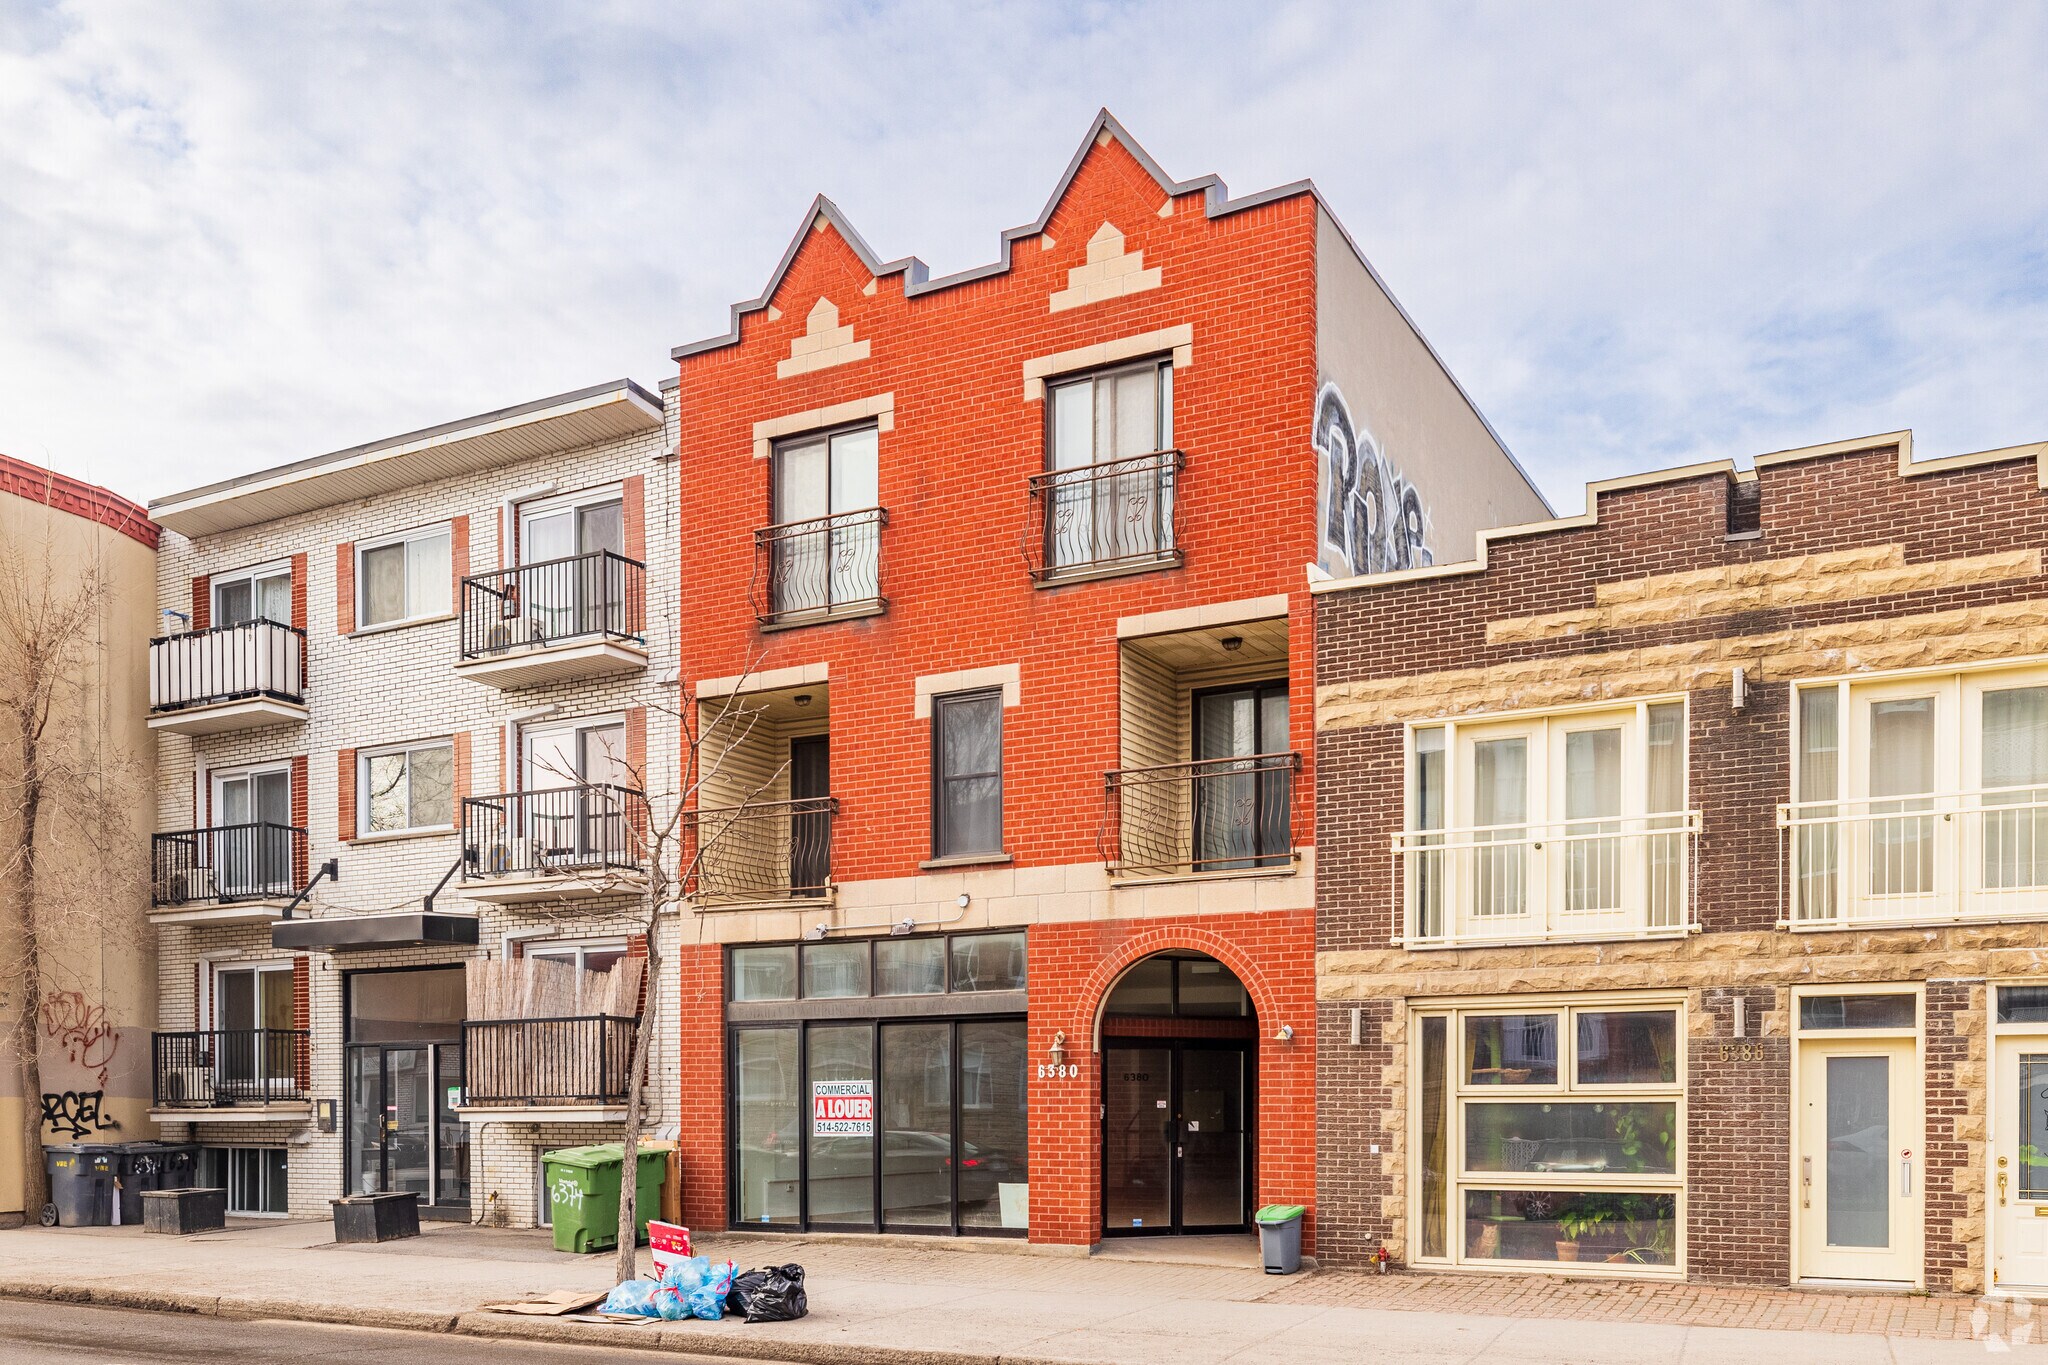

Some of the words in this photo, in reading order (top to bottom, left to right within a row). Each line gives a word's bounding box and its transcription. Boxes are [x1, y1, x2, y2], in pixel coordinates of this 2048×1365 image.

[1720, 1043, 1764, 1061] 6386
[1038, 1064, 1078, 1078] 6380
[1124, 1073, 1149, 1082] 6380
[816, 1085, 870, 1095] COMMERCIAL
[817, 1099, 826, 1118] A
[828, 1099, 871, 1118] LOUER
[817, 1122, 871, 1132] 514-522-7615
[551, 1182, 584, 1211] 6374
